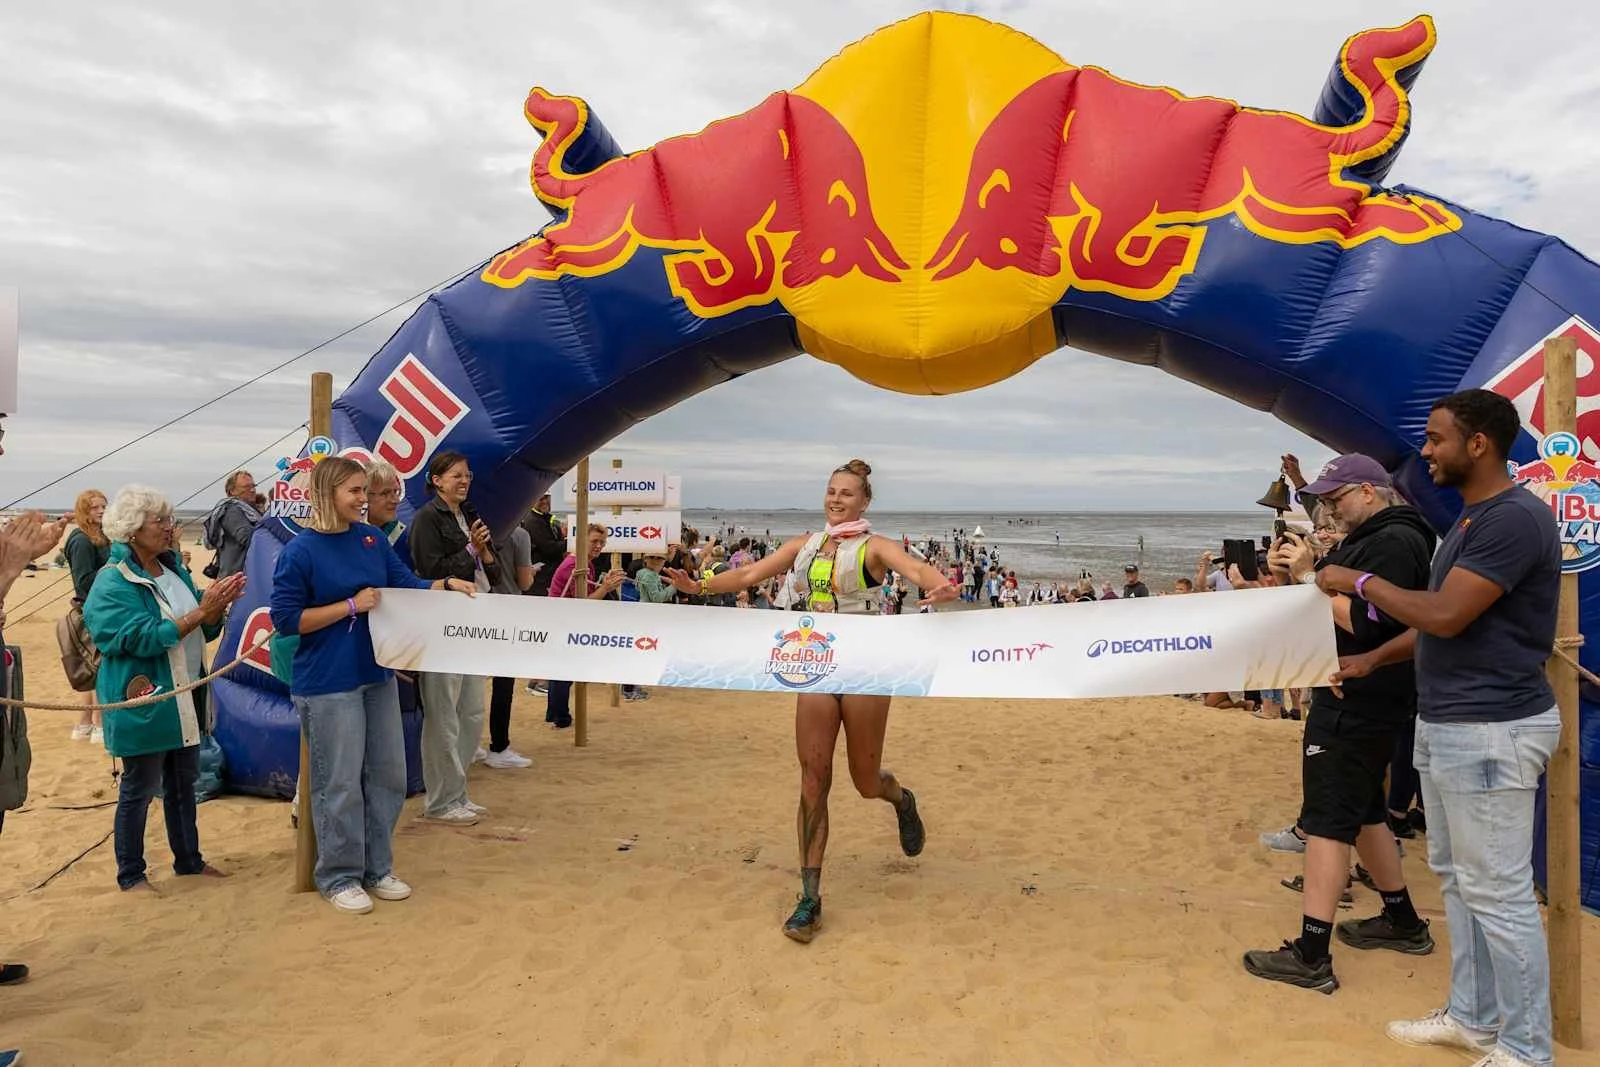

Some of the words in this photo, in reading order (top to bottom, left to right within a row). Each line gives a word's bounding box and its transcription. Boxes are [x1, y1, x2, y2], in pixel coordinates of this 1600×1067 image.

[340, 356, 465, 498] ull
[589, 481, 655, 491] DECATHLON
[443, 625, 508, 641] ICANIWILL
[518, 629, 548, 643] ICIW
[567, 632, 634, 648] NORDSEE
[1111, 635, 1212, 654] DECATHLON
[771, 647, 801, 661] Red
[804, 649, 834, 662] Bull
[972, 647, 1037, 663] IONITY
[765, 661, 837, 676] WATTLAUF
